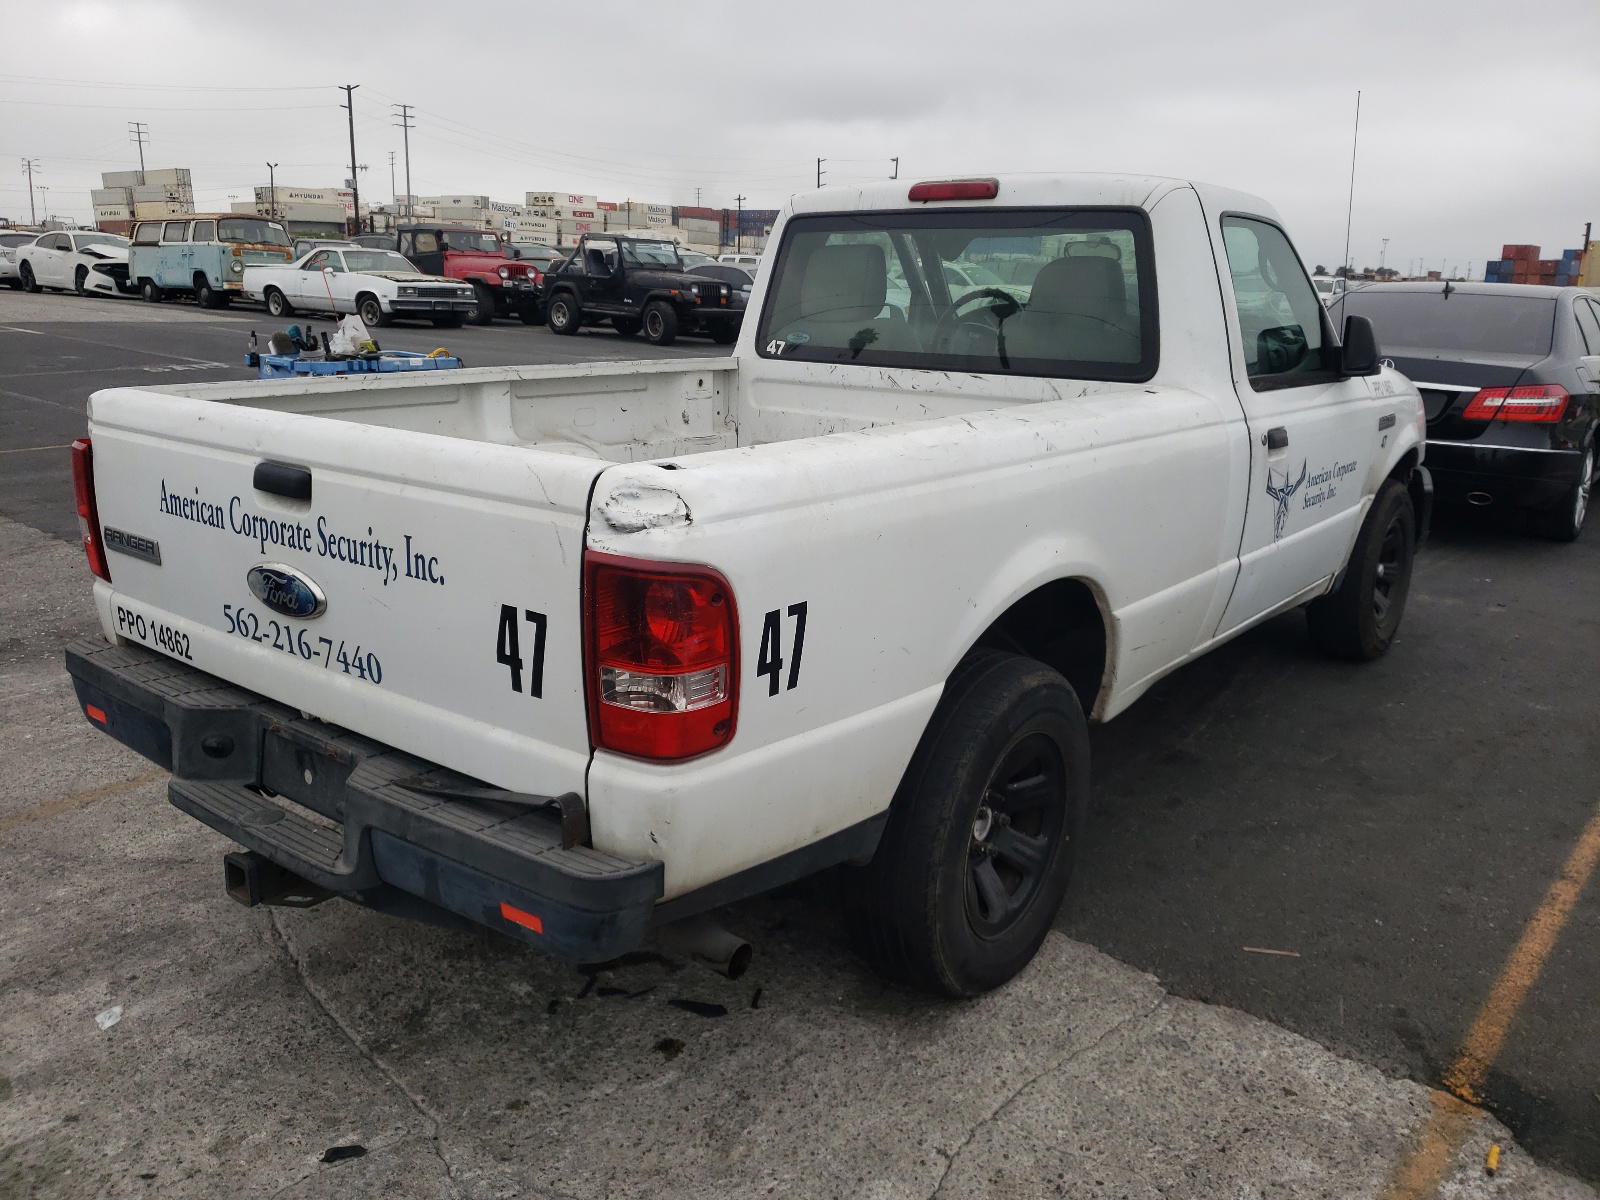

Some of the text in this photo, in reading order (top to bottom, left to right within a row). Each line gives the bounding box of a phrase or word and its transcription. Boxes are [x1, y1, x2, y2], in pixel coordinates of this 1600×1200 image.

[568, 195, 584, 204] ONE
[575, 222, 591, 232] ONE
[766, 339, 786, 355] 47
[1305, 461, 1358, 489] American Corporate
[104, 527, 156, 555] RANGER
[159, 478, 446, 586] American Corporate Security, Inc.
[262, 572, 299, 610] Ford
[117, 606, 193, 661] PPO 14862
[222, 604, 384, 686] 562-216-7440
[496, 603, 548, 699] 47
[756, 600, 808, 698] 47
